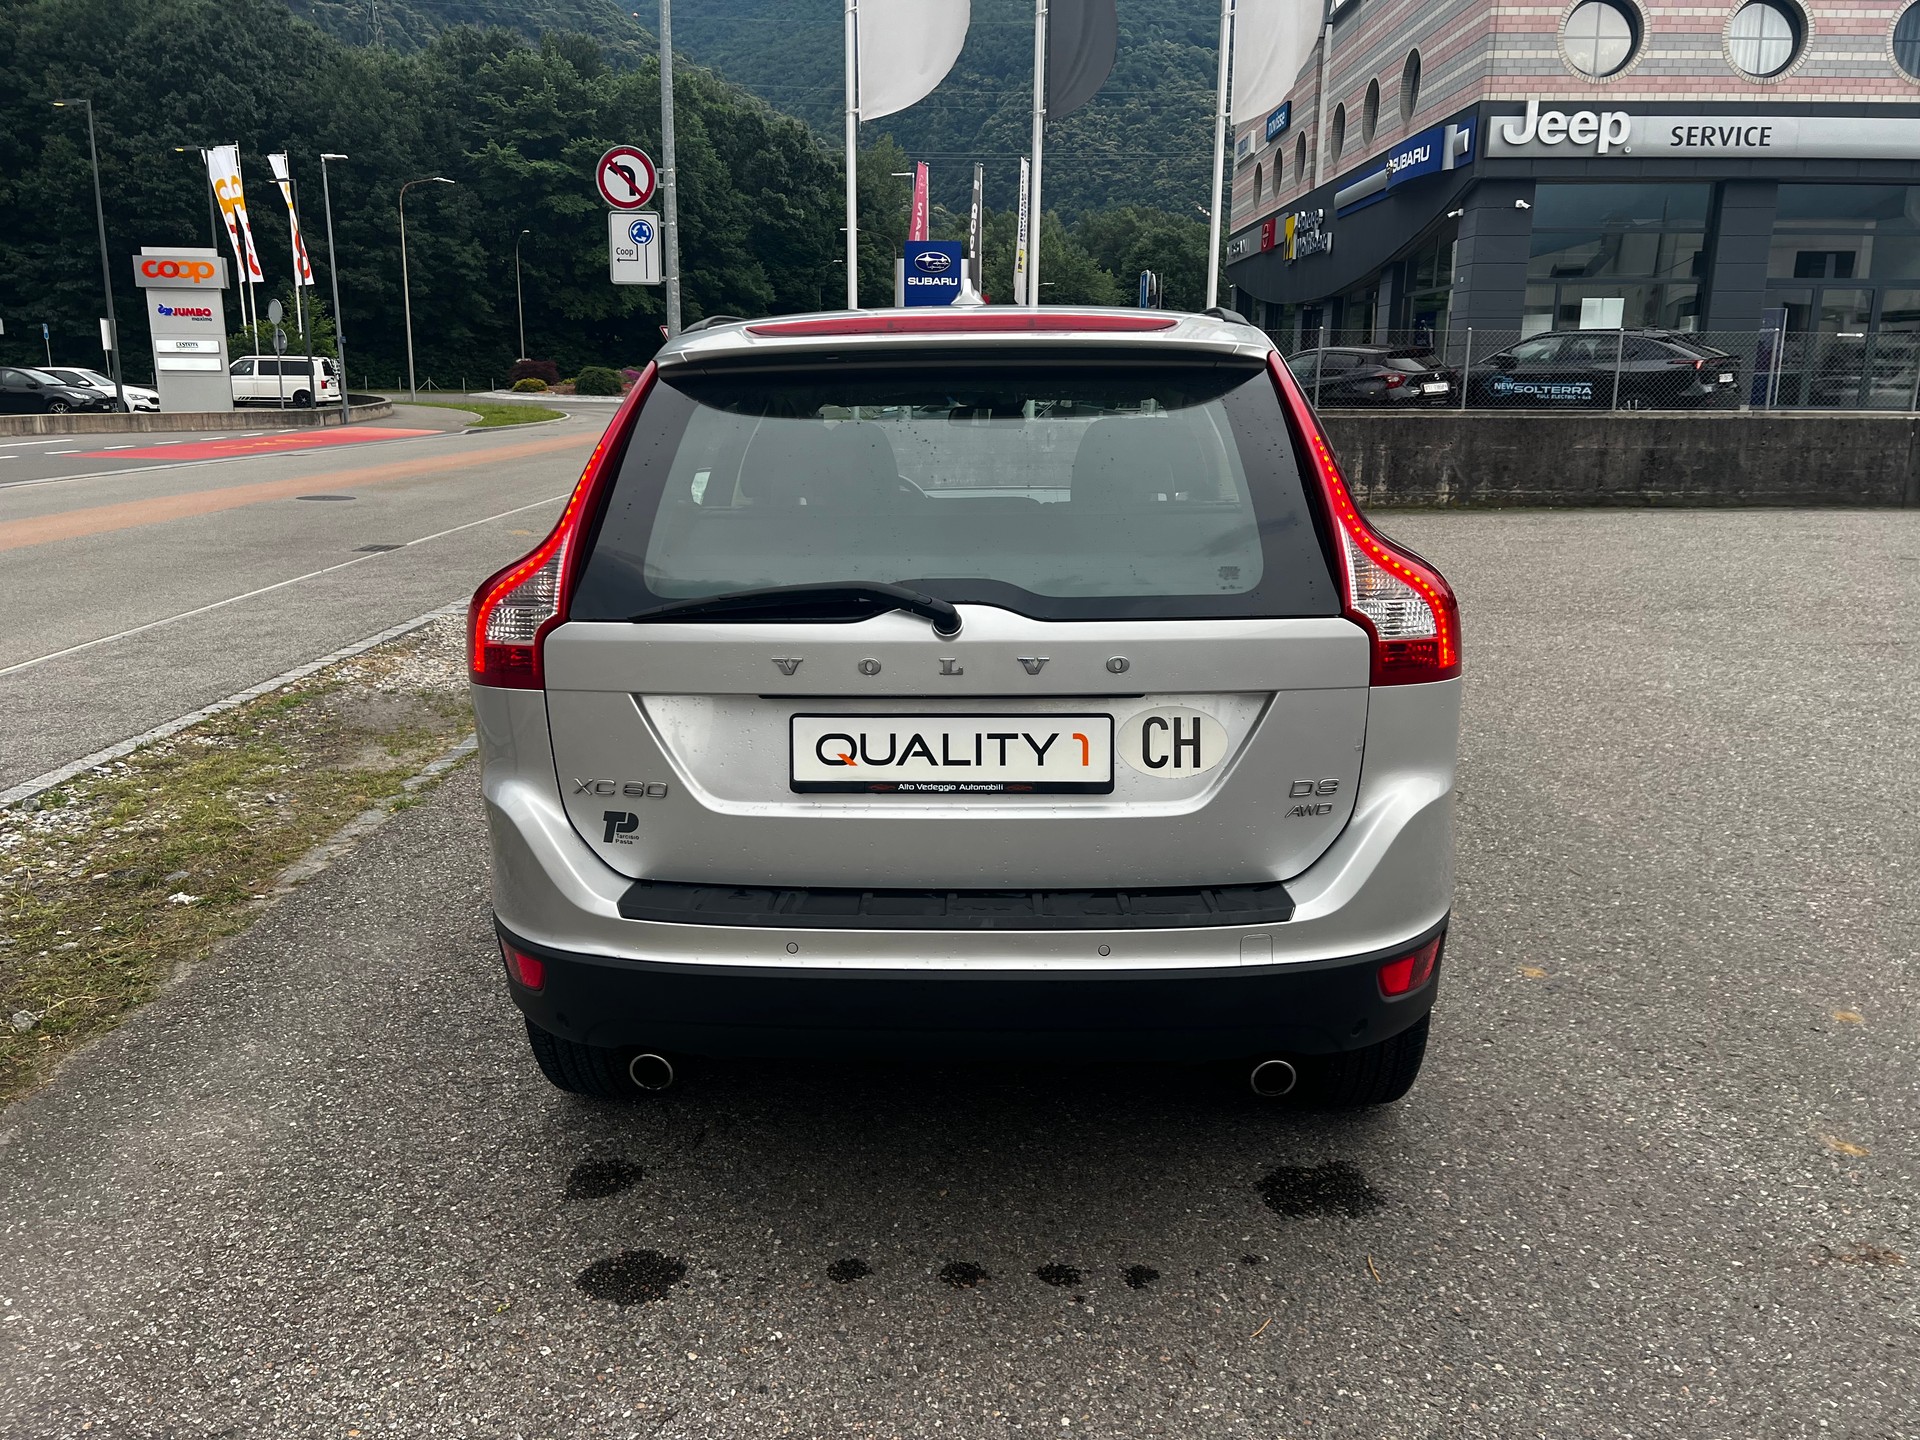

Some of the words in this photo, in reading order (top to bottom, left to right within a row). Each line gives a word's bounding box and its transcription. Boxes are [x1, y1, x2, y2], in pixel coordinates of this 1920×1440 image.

[1503, 100, 1631, 153] Jeep
[1669, 126, 1772, 147] SERVICE
[1392, 145, 1431, 174] SUBARU
[615, 247, 634, 257] Coop
[141, 260, 215, 284] coop
[907, 277, 958, 286] SUBARU
[172, 307, 212, 317] JUMBO
[1494, 382, 1514, 390] NEW
[1513, 385, 1593, 395] SOLTERRA
[771, 656, 1131, 677] VOLVO
[815, 733, 1060, 767] QUALITY
[1072, 733, 1090, 766] 1
[1141, 716, 1201, 769] CH
[898, 783, 915, 791] Alto
[917, 783, 956, 792] Vedeggio
[959, 783, 1004, 791] Automobili
[1284, 802, 1333, 818] AWD
